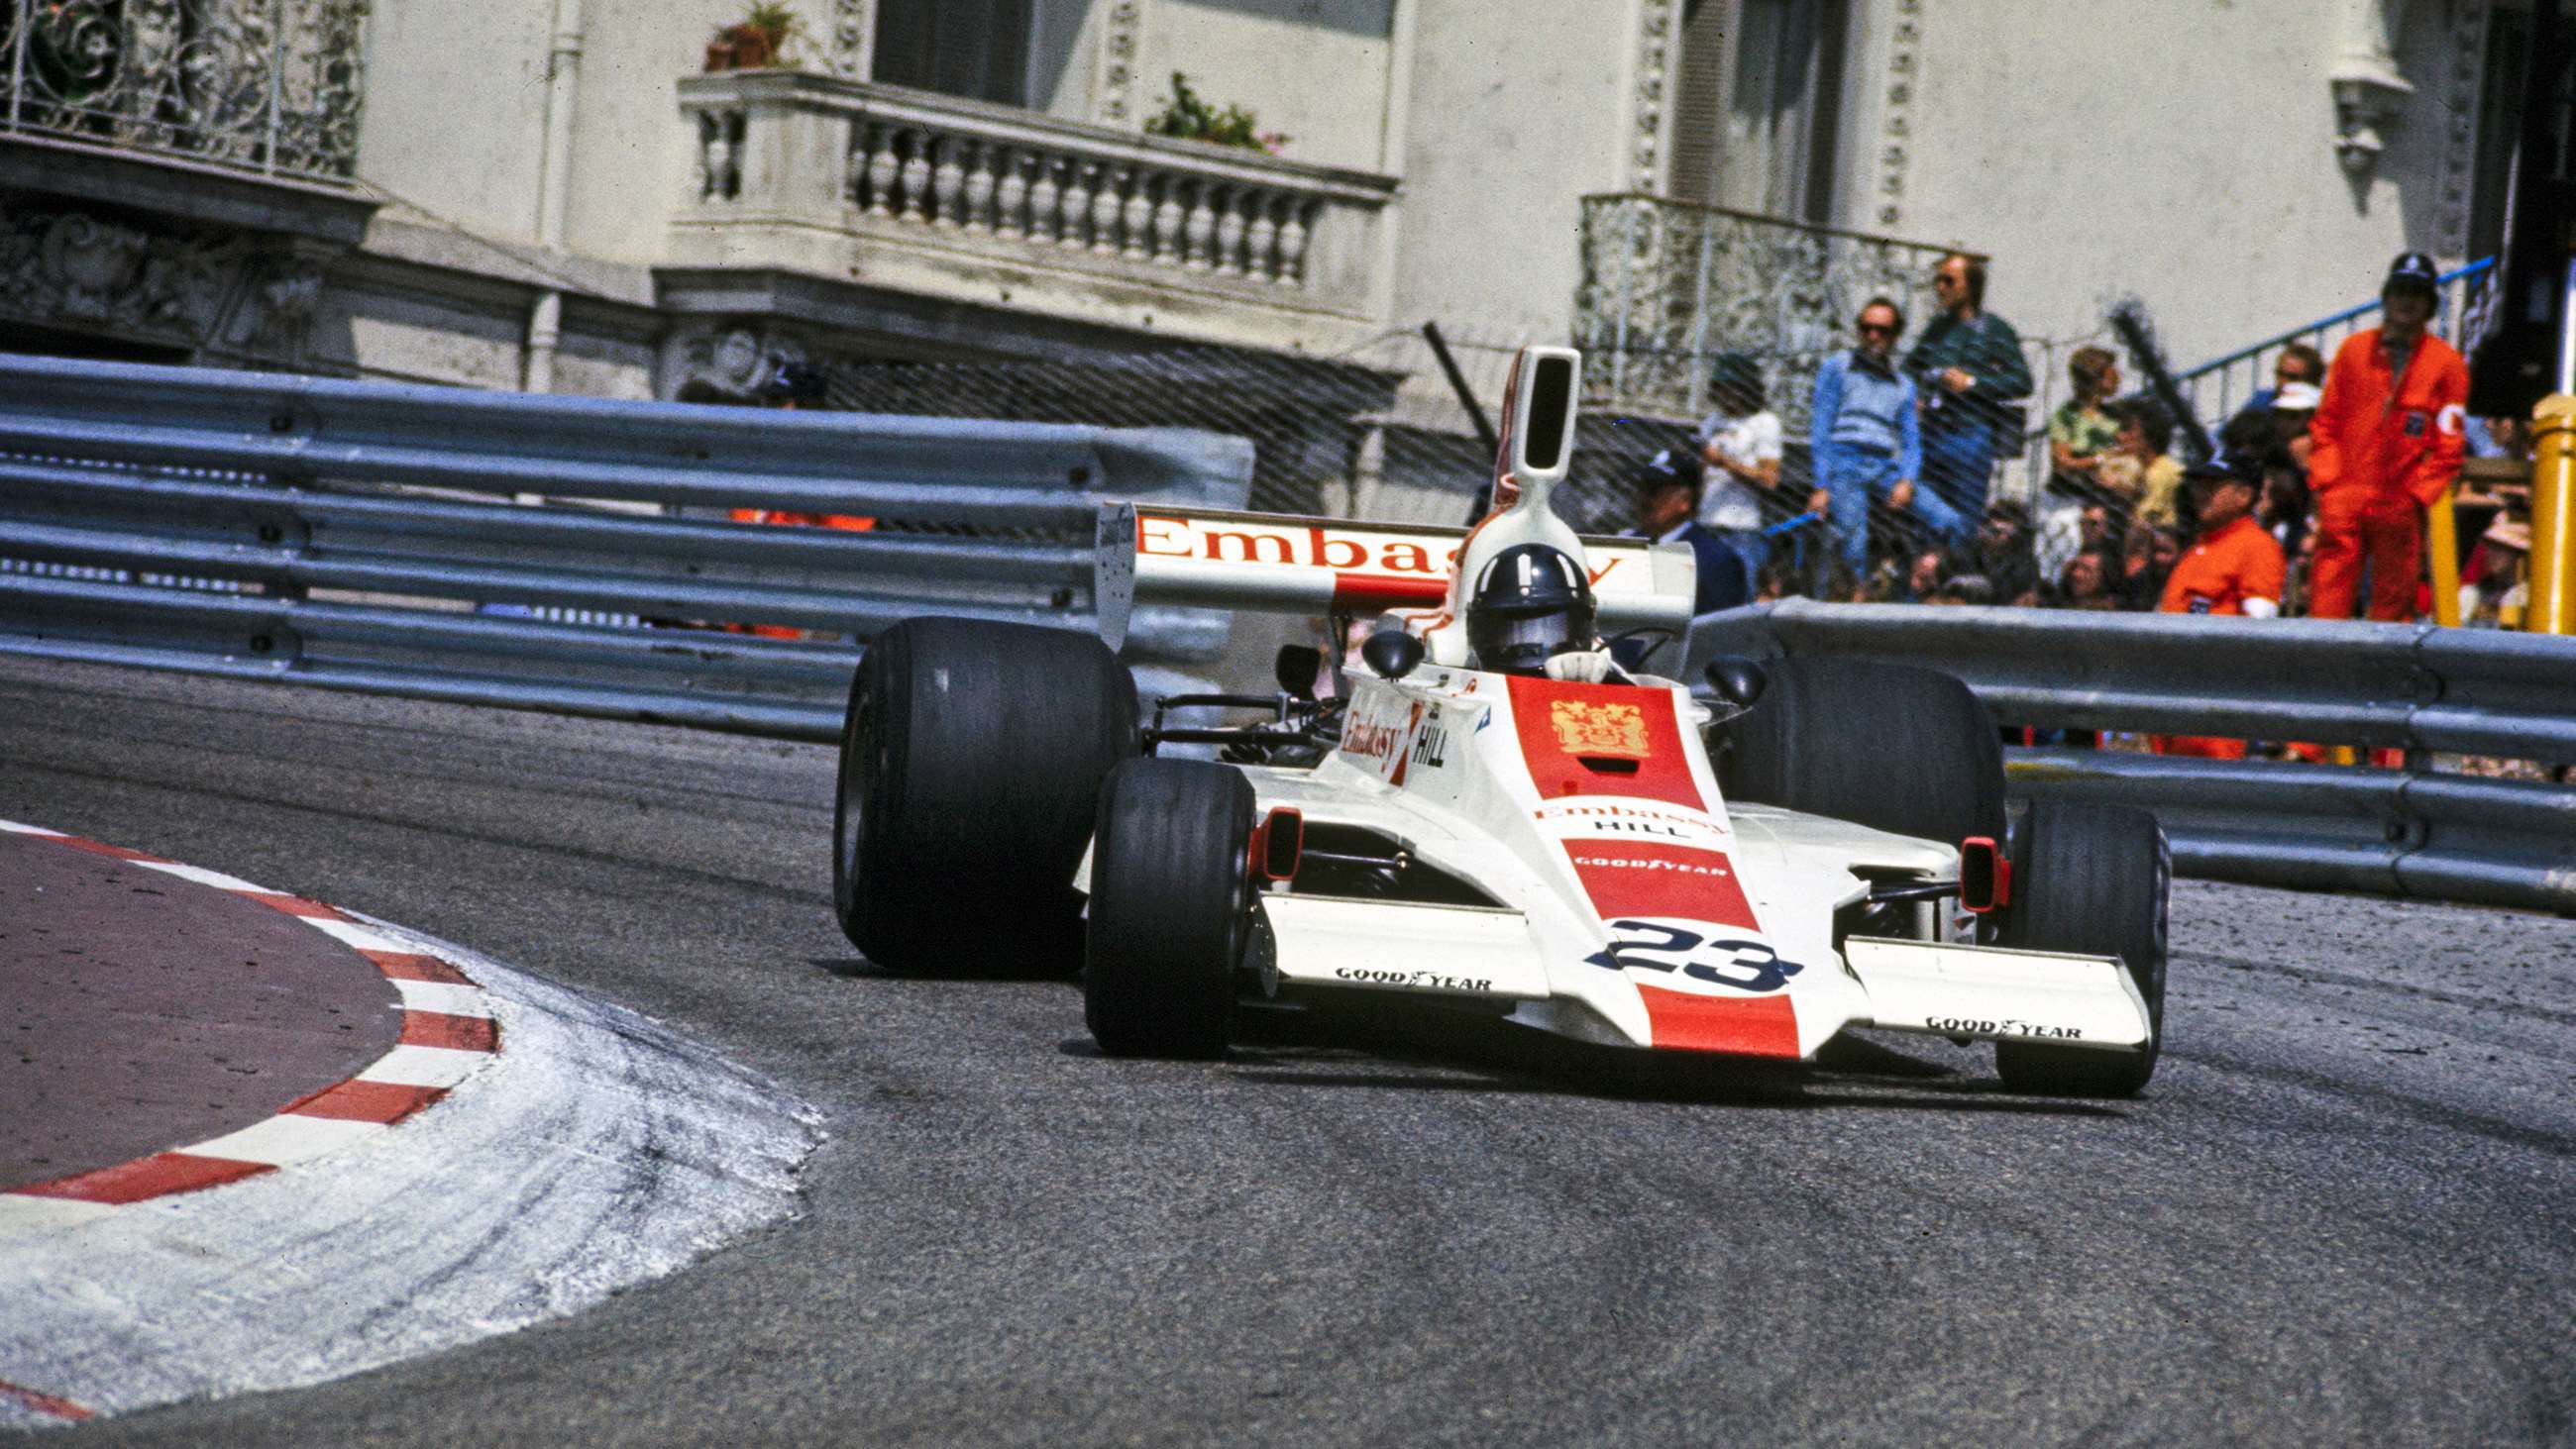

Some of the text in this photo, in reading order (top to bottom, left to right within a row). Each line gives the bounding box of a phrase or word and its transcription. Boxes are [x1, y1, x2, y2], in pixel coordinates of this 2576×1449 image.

[1412, 724, 1448, 769] HILL
[1534, 805, 1730, 834] Embassy
[1594, 821, 1691, 839] HILL
[1589, 920, 1795, 992] 23
